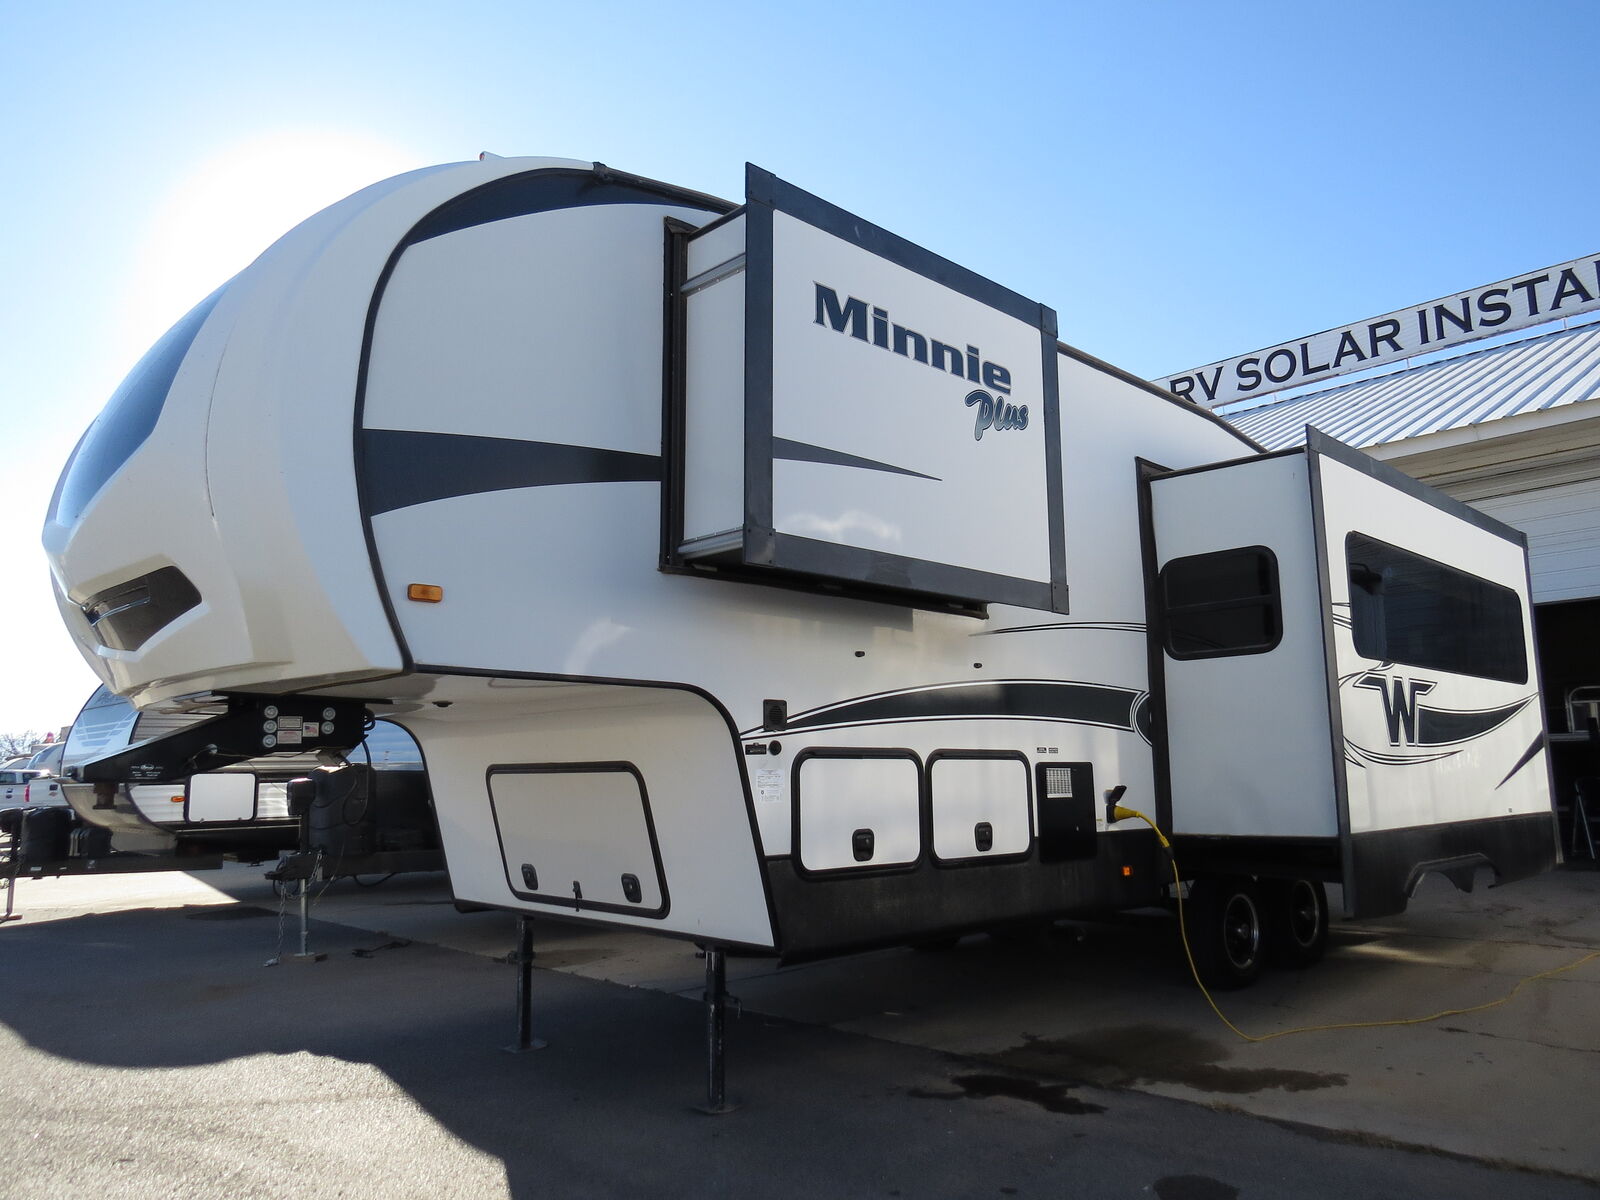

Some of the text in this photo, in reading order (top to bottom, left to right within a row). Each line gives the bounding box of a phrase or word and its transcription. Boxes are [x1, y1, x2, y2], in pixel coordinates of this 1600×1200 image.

[813, 280, 1011, 395] Minnie
[1169, 366, 1224, 404] RV
[1236, 318, 1403, 392] SOLAR
[965, 389, 1029, 441] Plus
